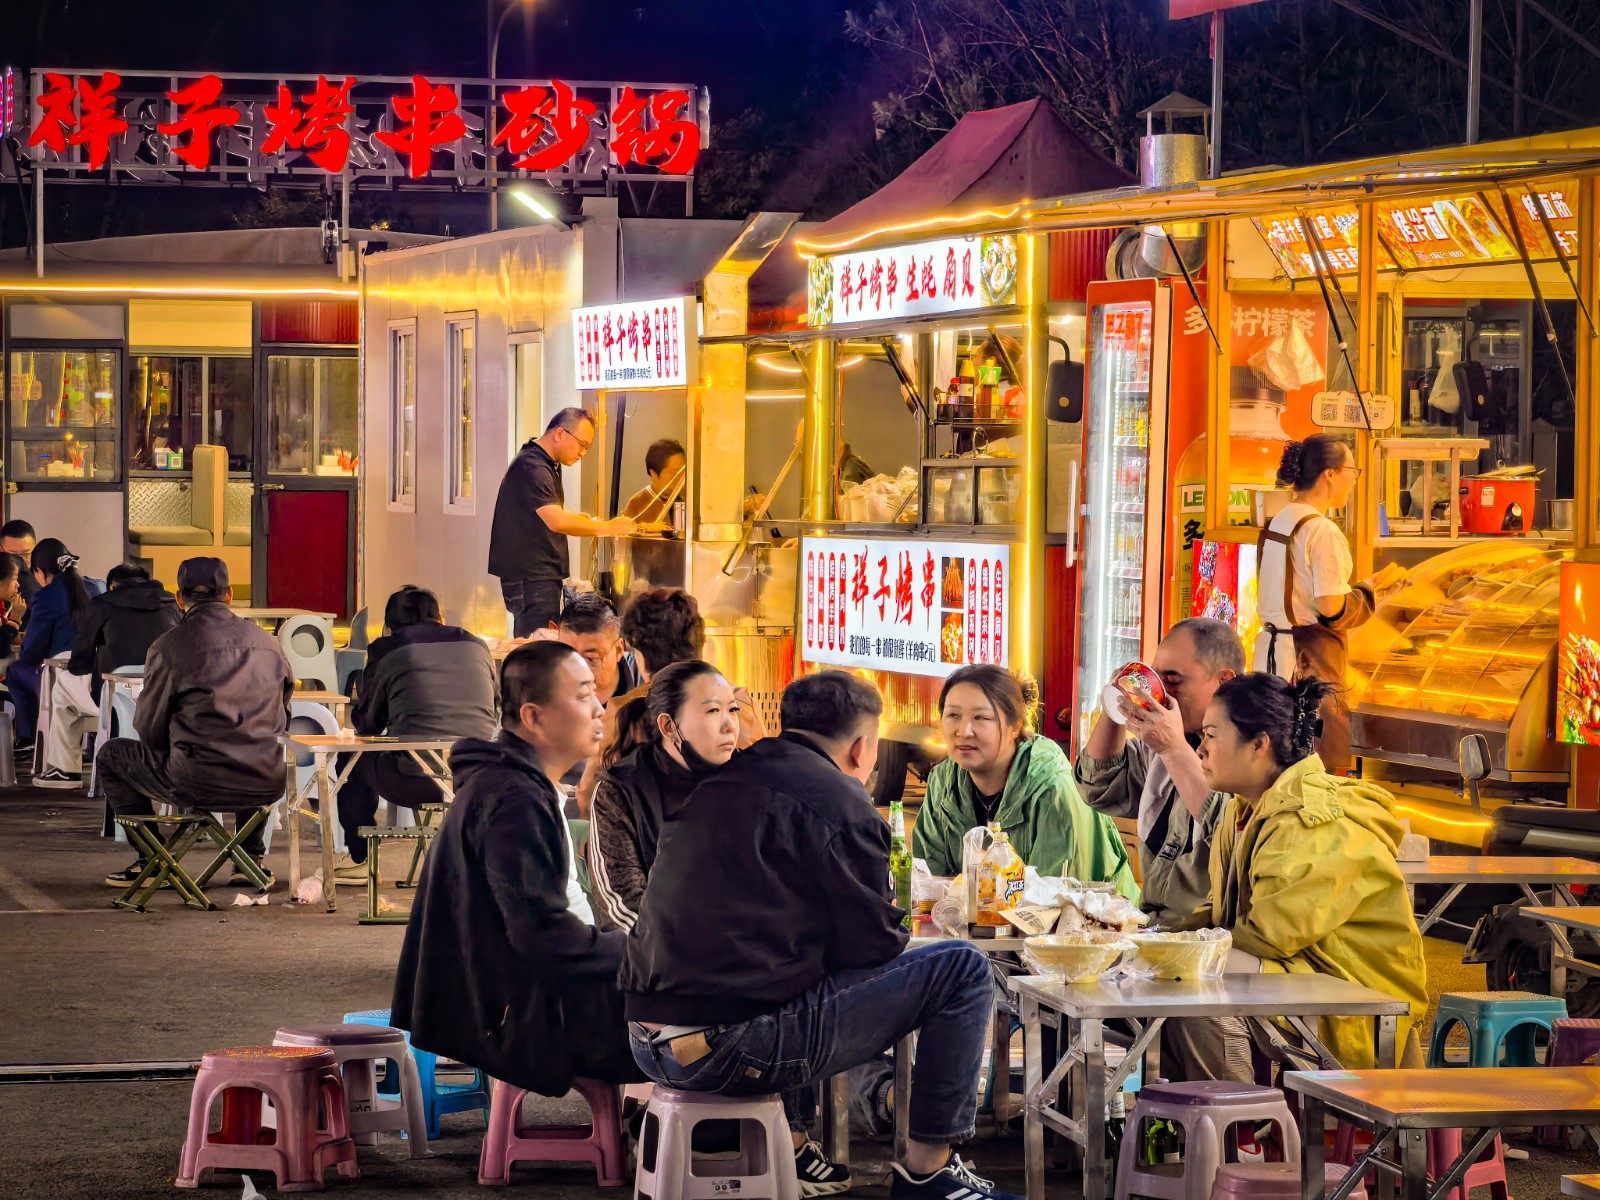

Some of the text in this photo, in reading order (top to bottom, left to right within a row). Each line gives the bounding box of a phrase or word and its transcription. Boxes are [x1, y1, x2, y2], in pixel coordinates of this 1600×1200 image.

[28, 72, 703, 178] 祥子烤串砂锅
[1390, 206, 1450, 243] 烤冷面
[839, 246, 975, 317] 祥子烤串 生蚝 扇贝
[602, 310, 652, 366] 祥子烤串
[1183, 304, 1317, 337] 多柠檬茶
[851, 544, 936, 632] 祥子烤串
